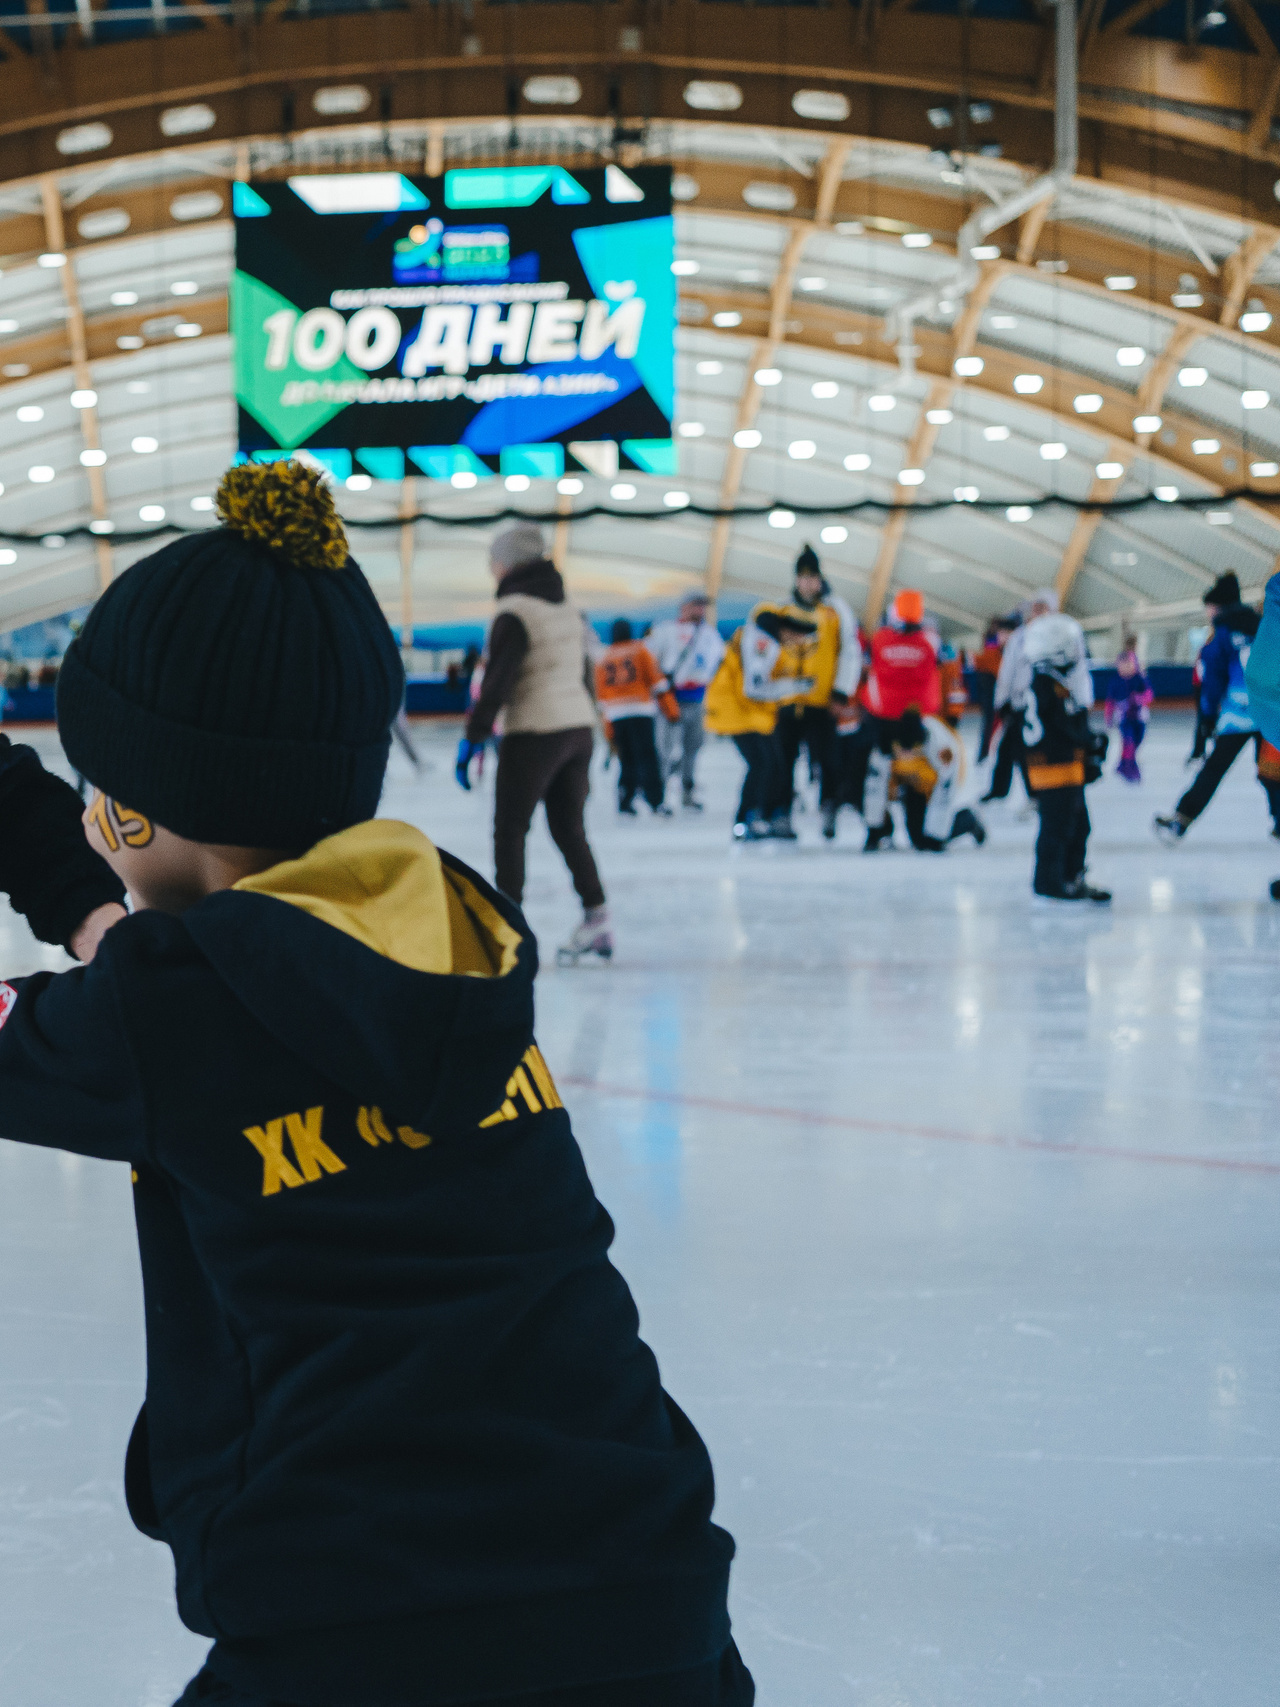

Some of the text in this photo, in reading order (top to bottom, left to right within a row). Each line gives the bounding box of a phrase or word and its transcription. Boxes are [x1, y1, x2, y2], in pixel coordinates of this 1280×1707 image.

[263, 279, 646, 378] 100 ДНЕЙ
[241, 1105, 348, 1197] ХК
